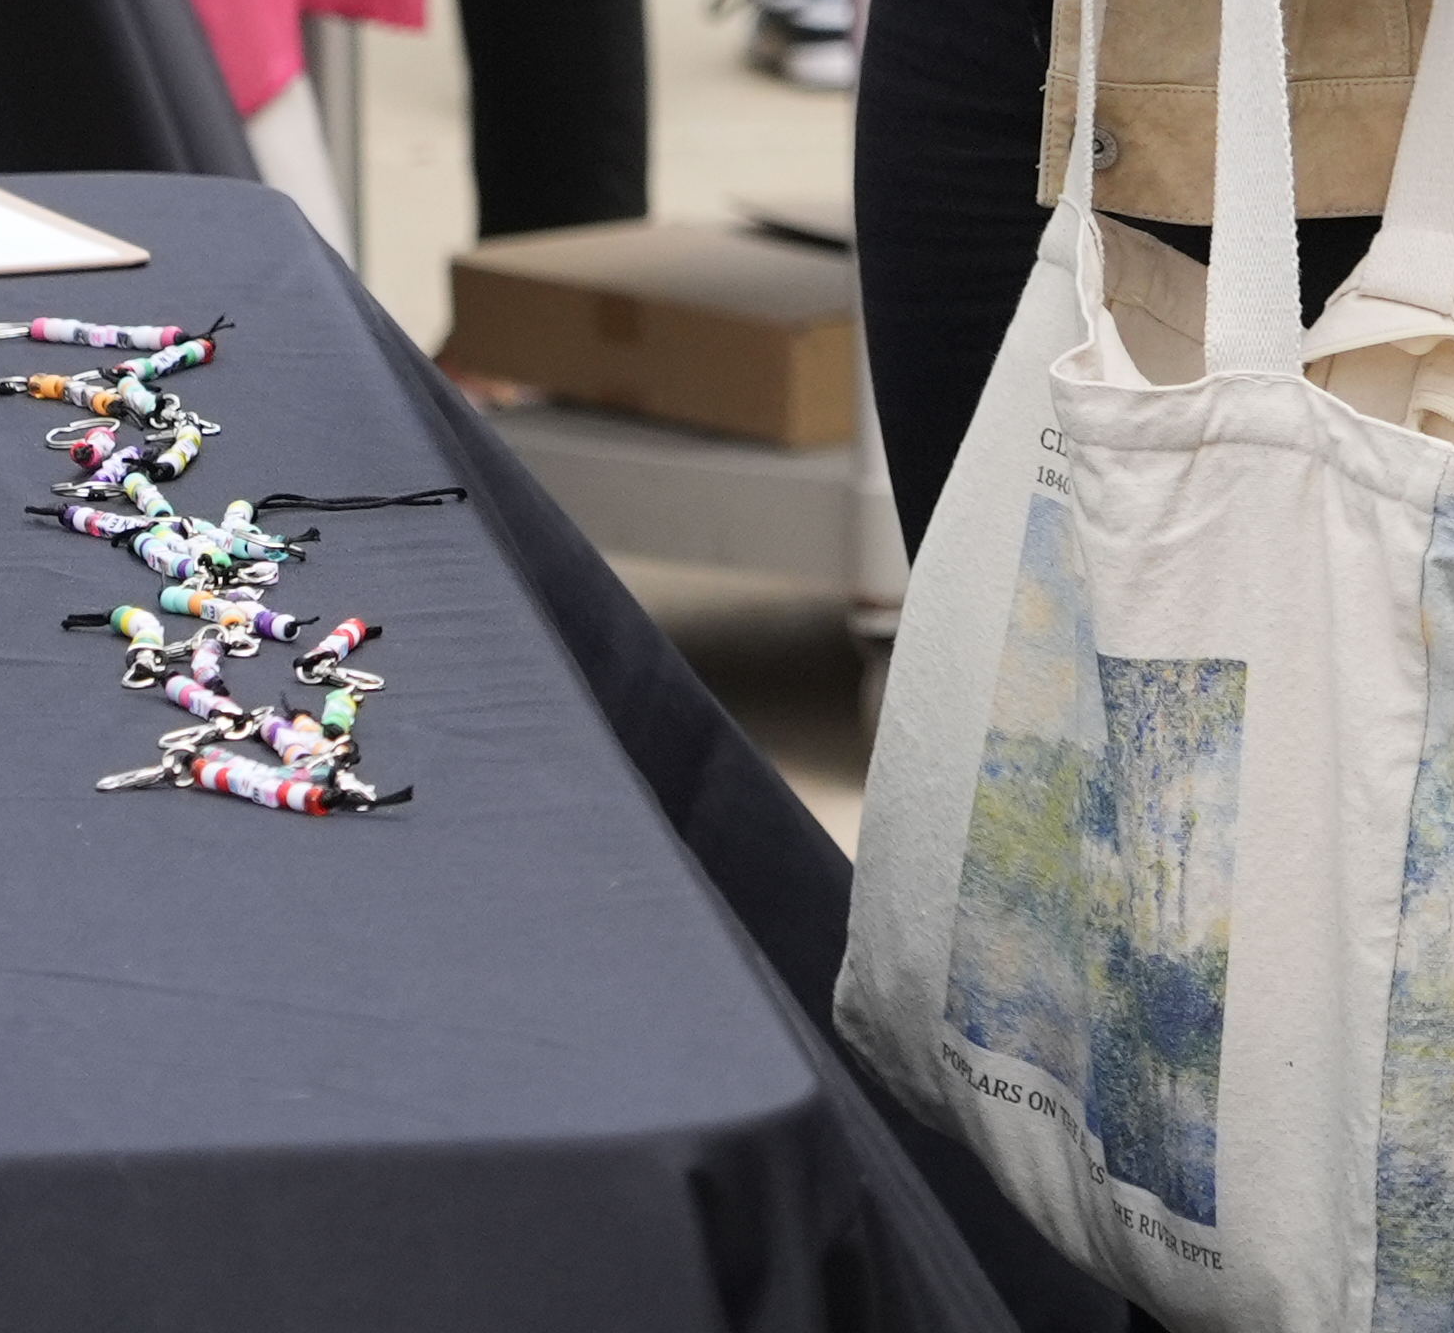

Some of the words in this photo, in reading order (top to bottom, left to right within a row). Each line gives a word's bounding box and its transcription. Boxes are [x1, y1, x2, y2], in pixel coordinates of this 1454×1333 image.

[1036, 465, 1071, 495] 1840
[941, 1042, 1022, 1104] POPLARS
[1029, 1091, 1057, 1119] ON
[1139, 1212, 1179, 1254] RIVER
[1182, 1239, 1223, 1271] EPTE
